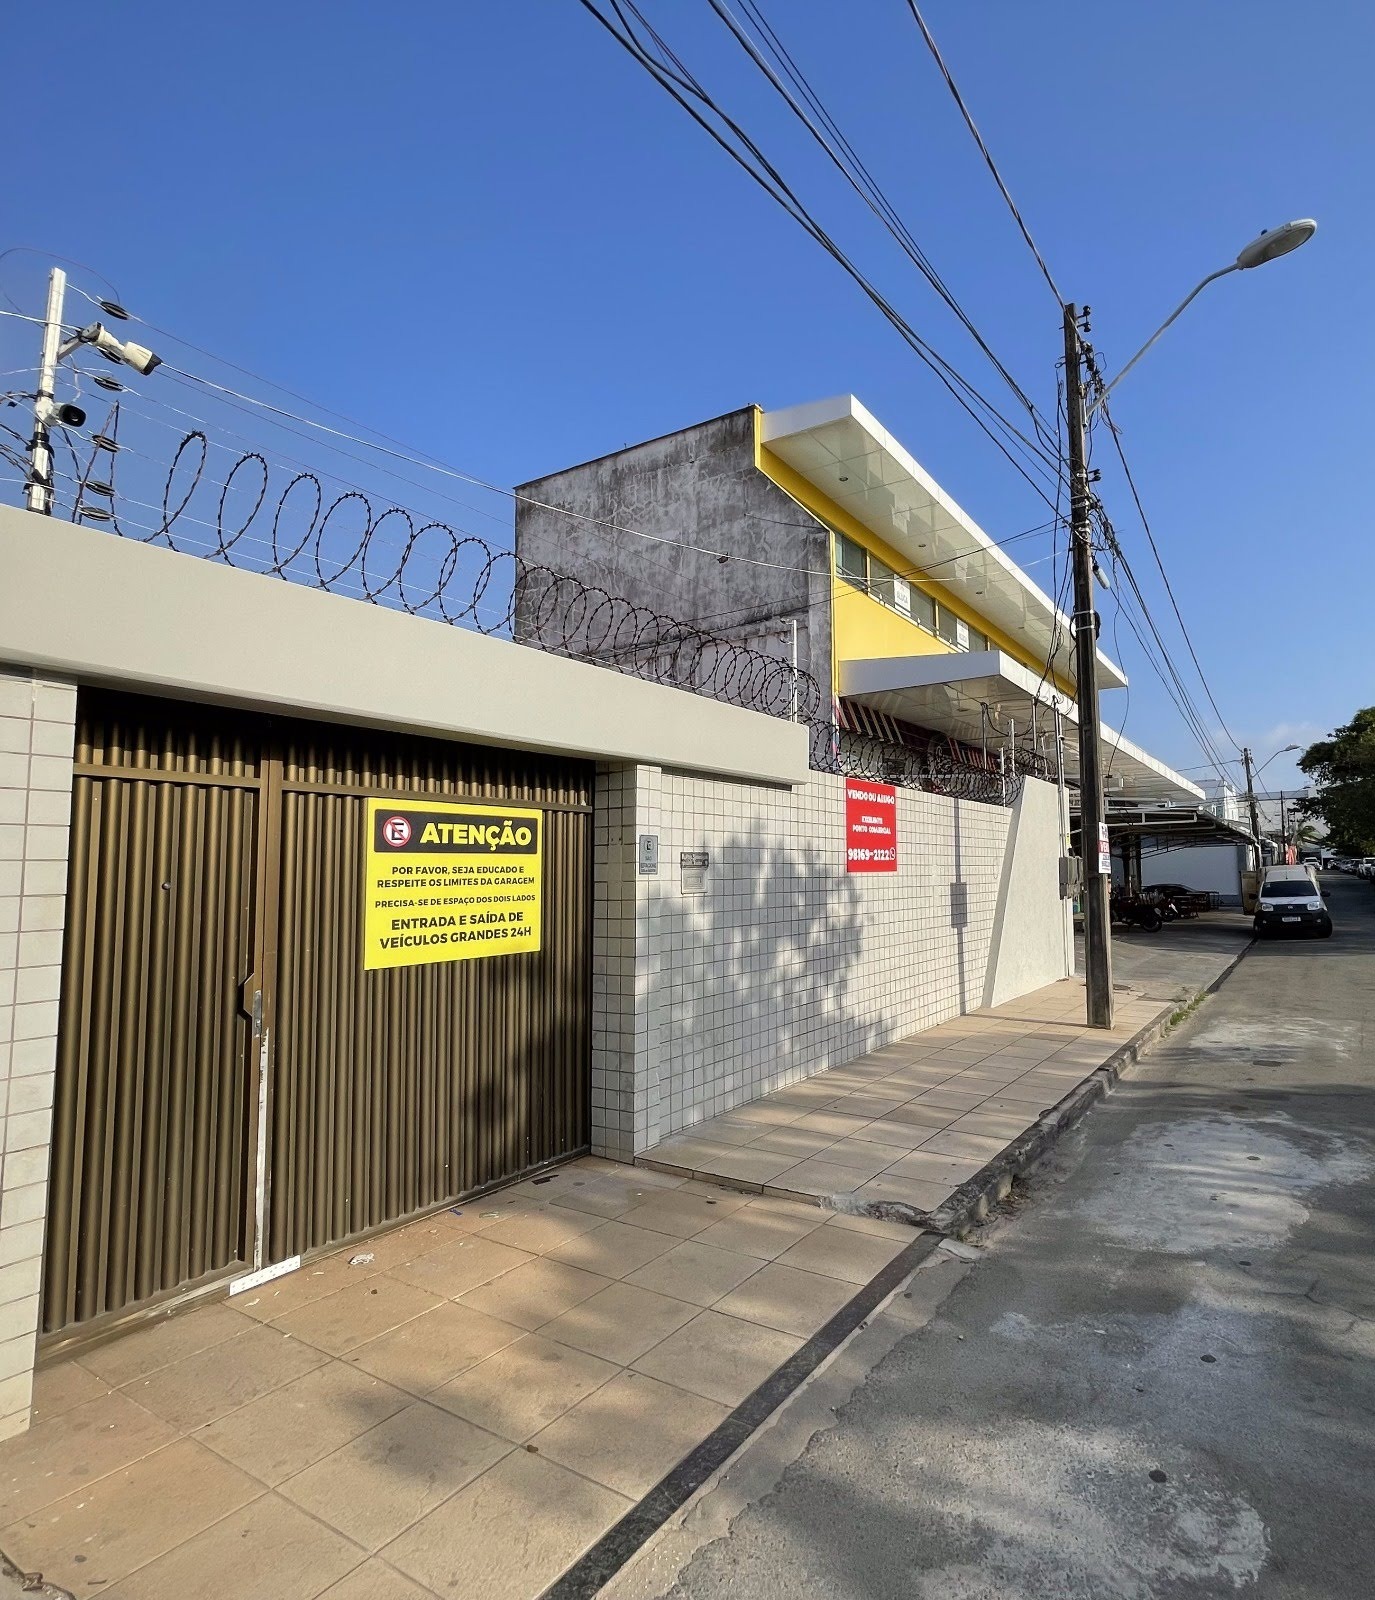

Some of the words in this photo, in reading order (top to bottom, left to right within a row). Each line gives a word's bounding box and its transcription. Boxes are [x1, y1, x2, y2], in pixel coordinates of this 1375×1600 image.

[848, 789, 868, 800] VENDO
[869, 792, 876, 802] OU
[877, 794, 894, 804] ALUGO
[420, 820, 532, 851] ATENÇÃO
[848, 848, 890, 860] 98169-2122
[392, 866, 413, 875] POR
[416, 866, 450, 875] FAVOR,
[377, 880, 427, 888] RESPEITE
[429, 879, 442, 887] OS
[444, 878, 478, 886] LIMITES
[494, 877, 534, 885] GARAGEM
[375, 899, 429, 908] PRECISA-SE
[444, 897, 474, 906] ESPAÇO
[392, 916, 456, 930] ENTRADA
[460, 916, 466, 925] E
[470, 911, 505, 924] SAÍDA
[508, 912, 523, 922] DE
[380, 934, 447, 949] VEÍCULOS
[450, 929, 508, 942] GRANDES
[510, 926, 531, 938] 24H
